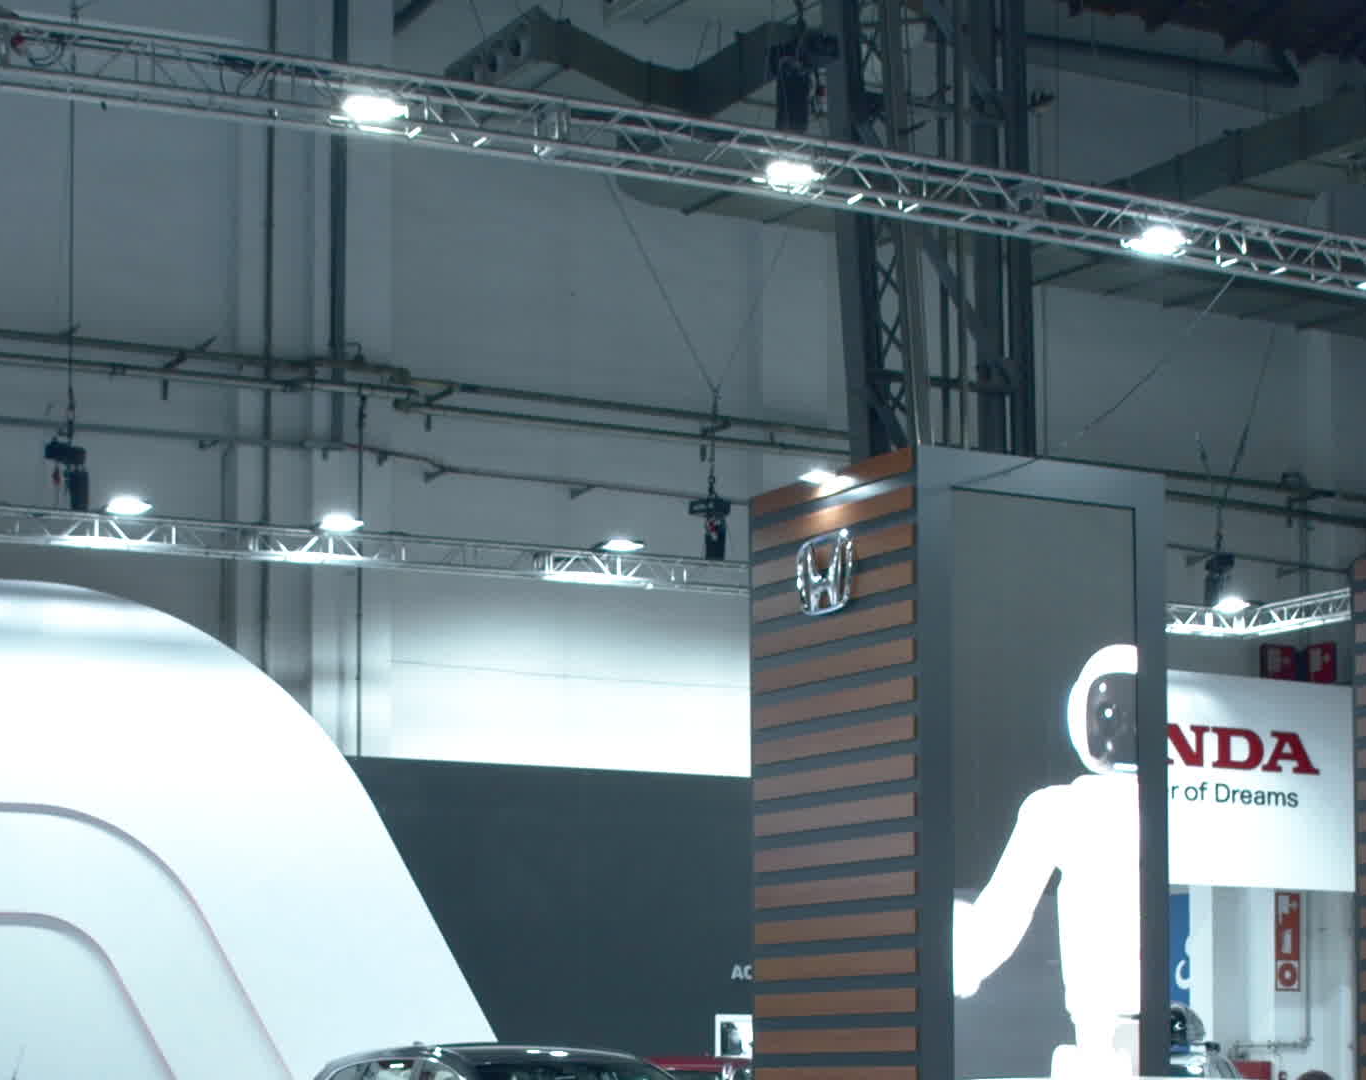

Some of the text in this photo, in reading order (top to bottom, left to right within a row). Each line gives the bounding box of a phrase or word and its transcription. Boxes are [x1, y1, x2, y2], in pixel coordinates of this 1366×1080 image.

[1166, 722, 1320, 775] NDA
[1184, 781, 1208, 802] of
[1215, 783, 1299, 808] Dreams
